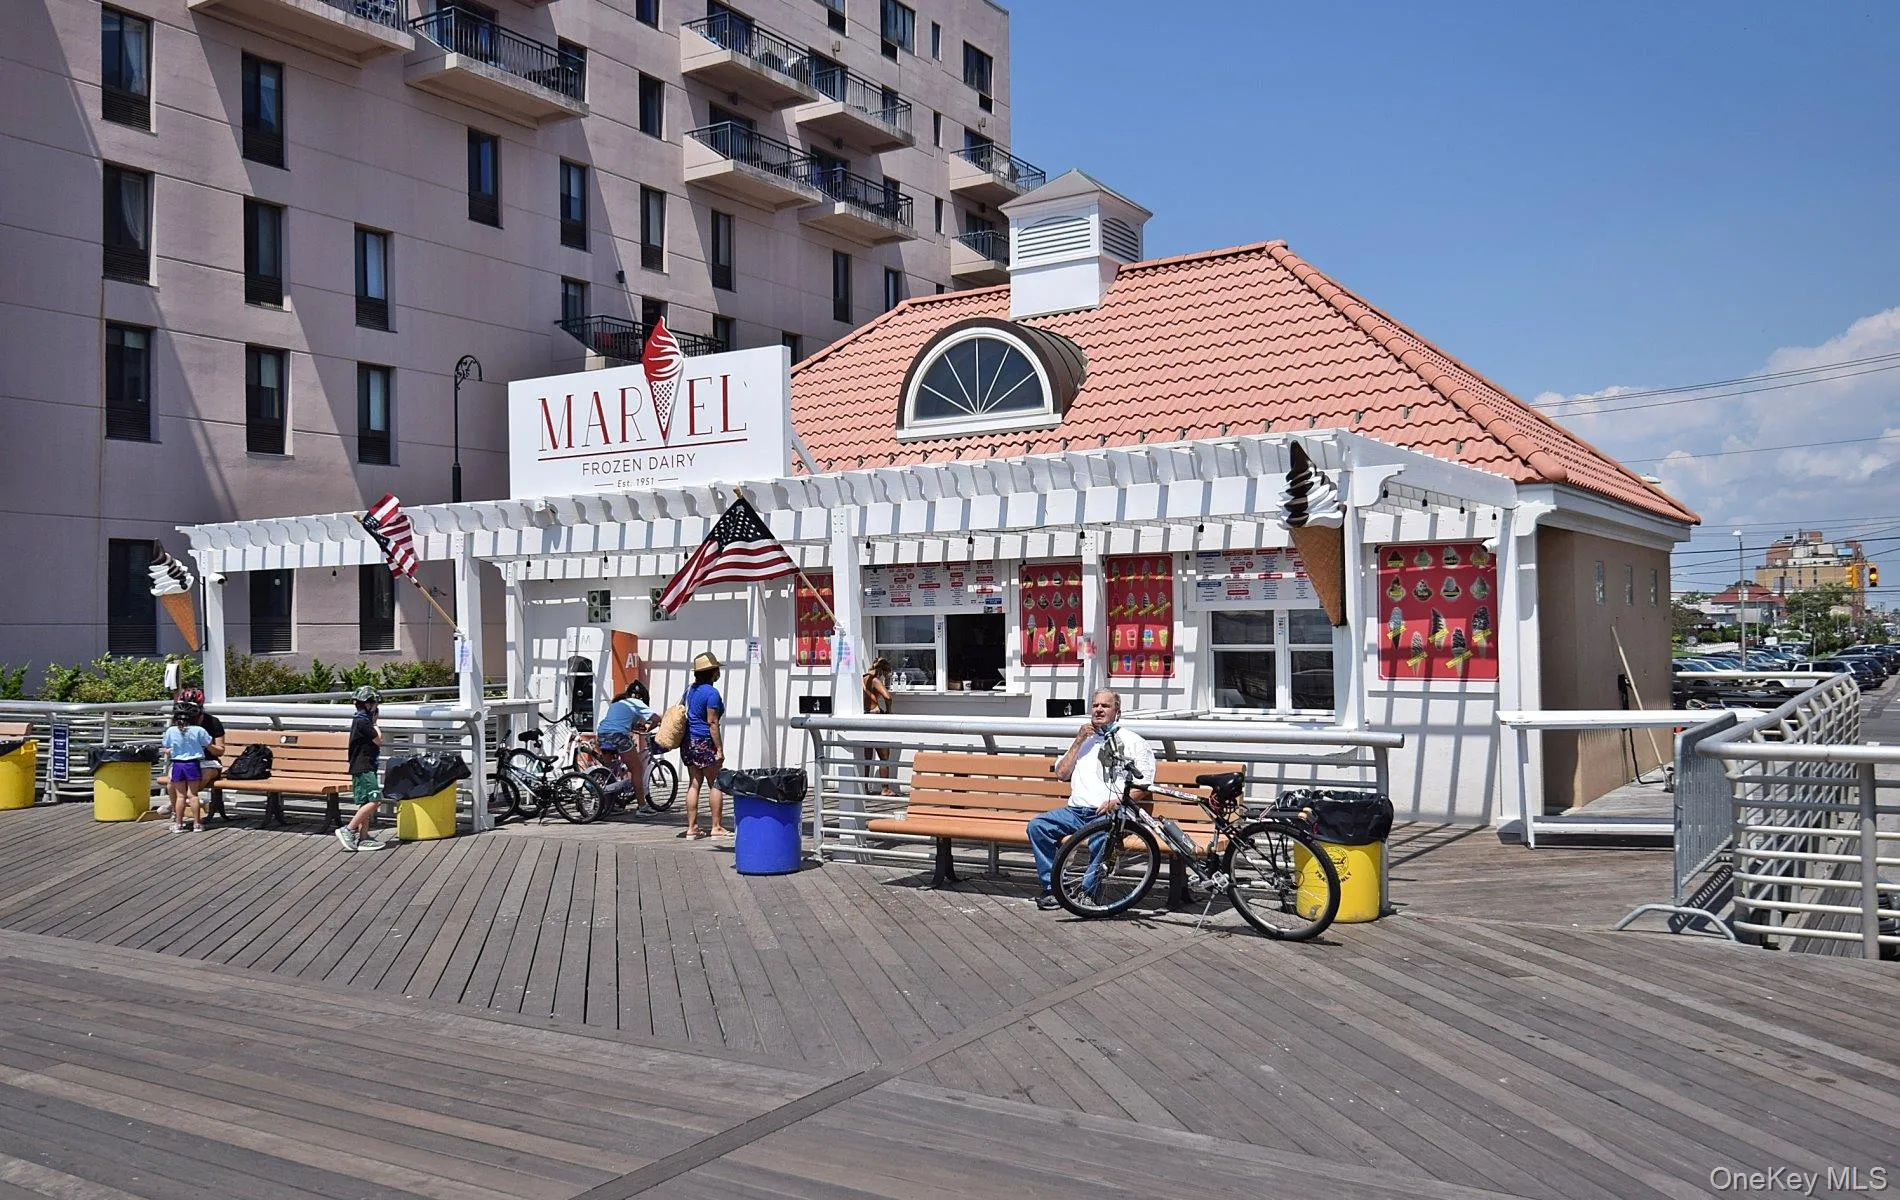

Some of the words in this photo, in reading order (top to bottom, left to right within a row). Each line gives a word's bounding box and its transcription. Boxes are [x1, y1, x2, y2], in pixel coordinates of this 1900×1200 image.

[537, 372, 748, 452] MARVEL
[582, 455, 642, 476] FROZEN
[649, 452, 697, 471] DAIRY
[617, 479, 633, 488] Est.
[636, 477, 654, 487] 1951
